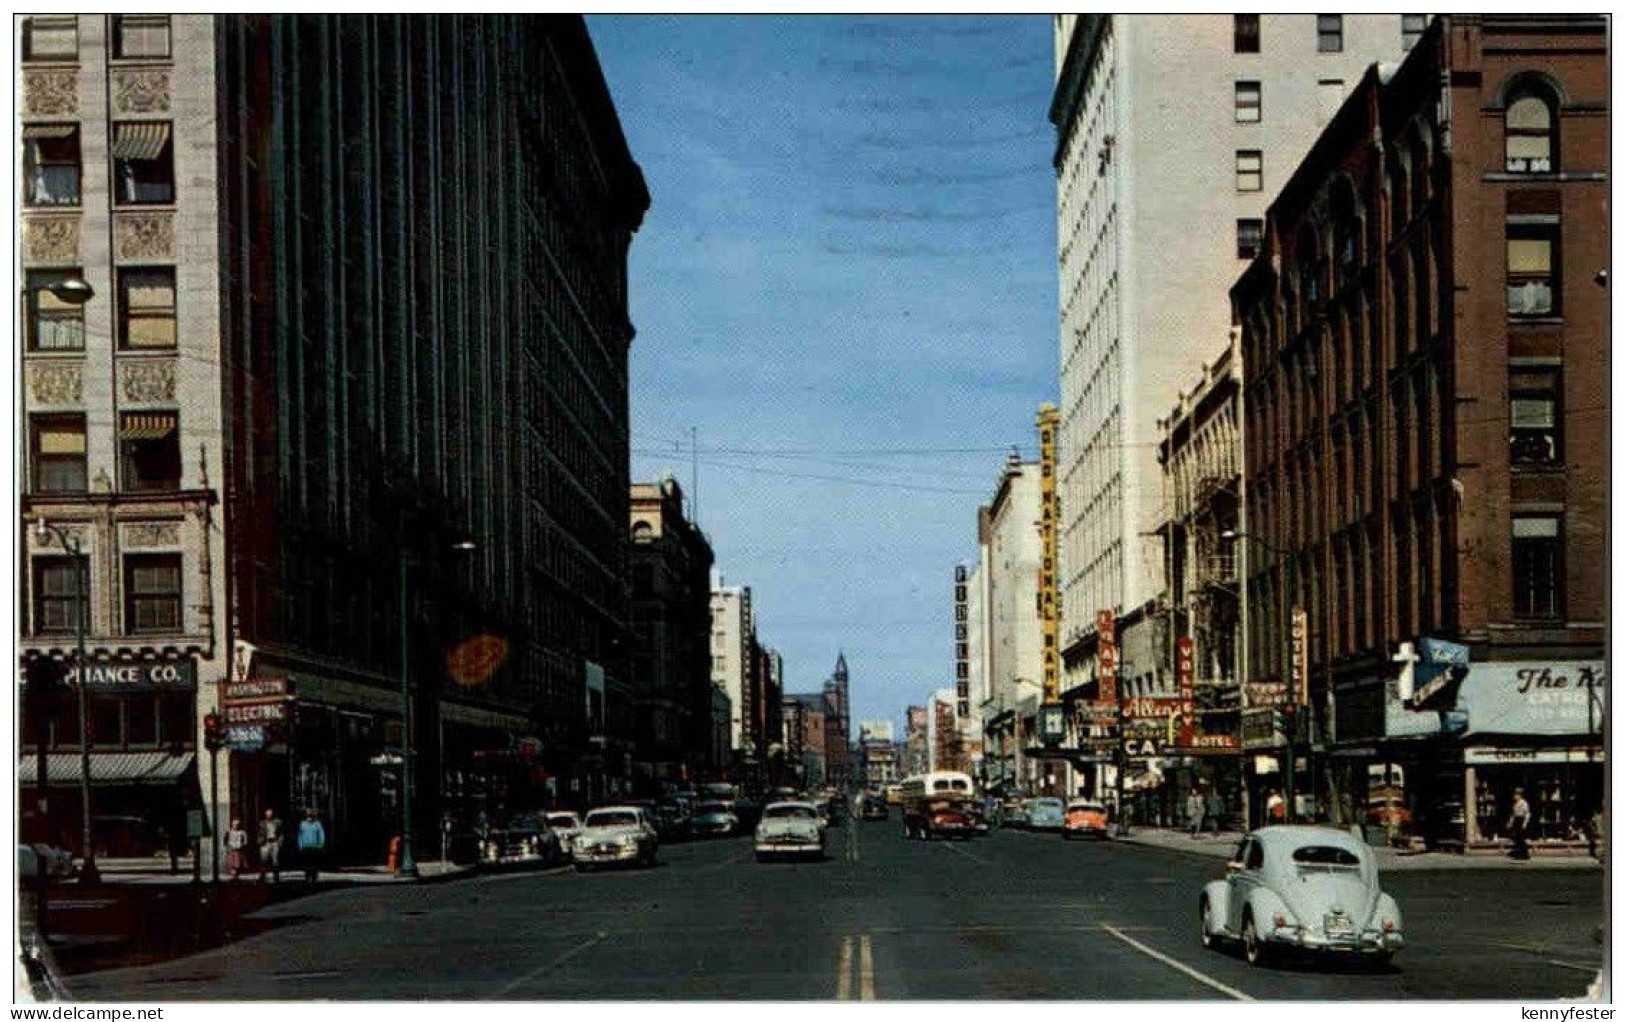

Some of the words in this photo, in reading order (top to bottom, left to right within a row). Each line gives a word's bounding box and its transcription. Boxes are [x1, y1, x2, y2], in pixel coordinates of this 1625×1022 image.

[1042, 491, 1053, 621] NATIONAL
[150, 666, 181, 682] CO.
[1044, 633, 1055, 699] BANK
[1517, 668, 1567, 694] The
[1191, 736, 1233, 747] HOTEL
